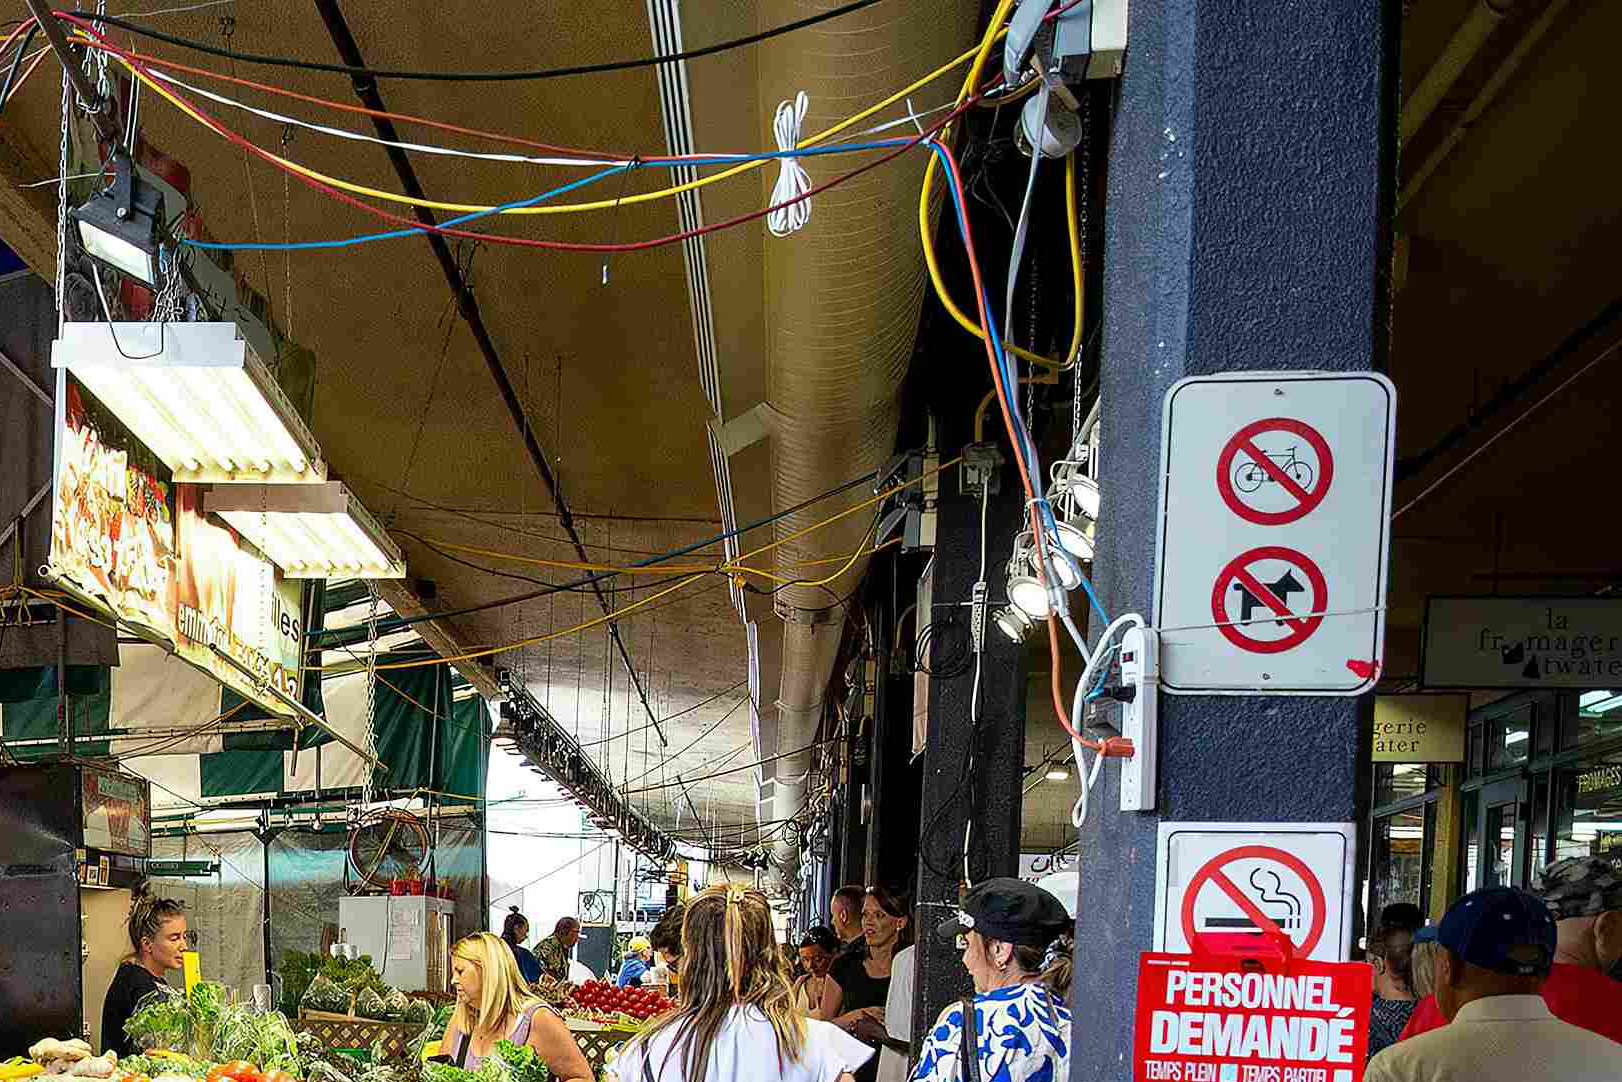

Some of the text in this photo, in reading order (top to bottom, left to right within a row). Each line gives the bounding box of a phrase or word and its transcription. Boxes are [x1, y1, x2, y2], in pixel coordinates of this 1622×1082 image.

[1545, 606, 1569, 630] la
[1165, 969, 1340, 1013] PERSONNEL
[1150, 1007, 1356, 1064] DEMANDÉ
[1144, 1060, 1182, 1081] TEMPS
[1184, 1062, 1217, 1082] PLEIN
